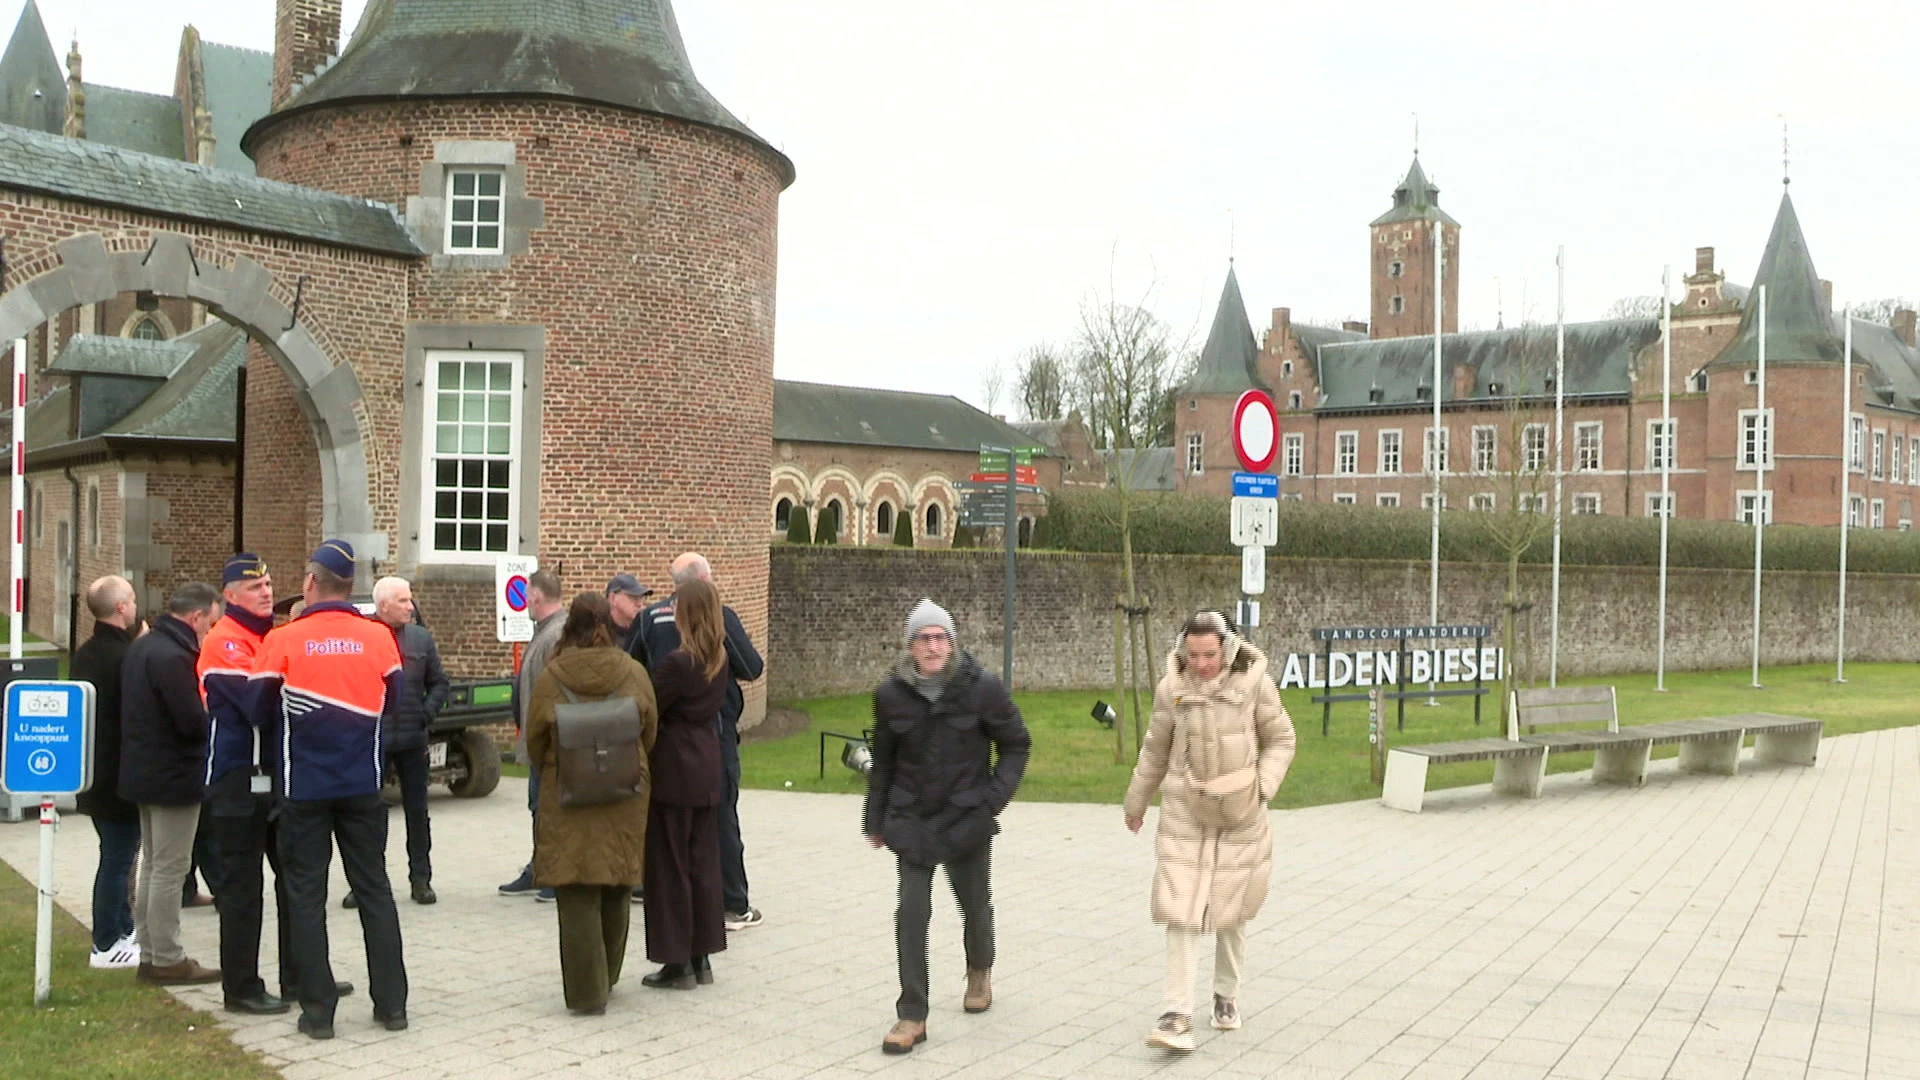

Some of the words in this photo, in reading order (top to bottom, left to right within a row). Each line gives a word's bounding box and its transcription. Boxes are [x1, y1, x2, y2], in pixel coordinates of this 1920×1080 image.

[507, 562, 528, 573] ZONE
[1320, 627, 1487, 640] LANDCOMMANDERIJ
[306, 638, 363, 656] Politie
[1280, 650, 1398, 690] ALDEN
[20, 723, 29, 733] U
[32, 723, 65, 733] nadert
[14, 732, 69, 744] knooppunt
[35, 756, 50, 770] 68
